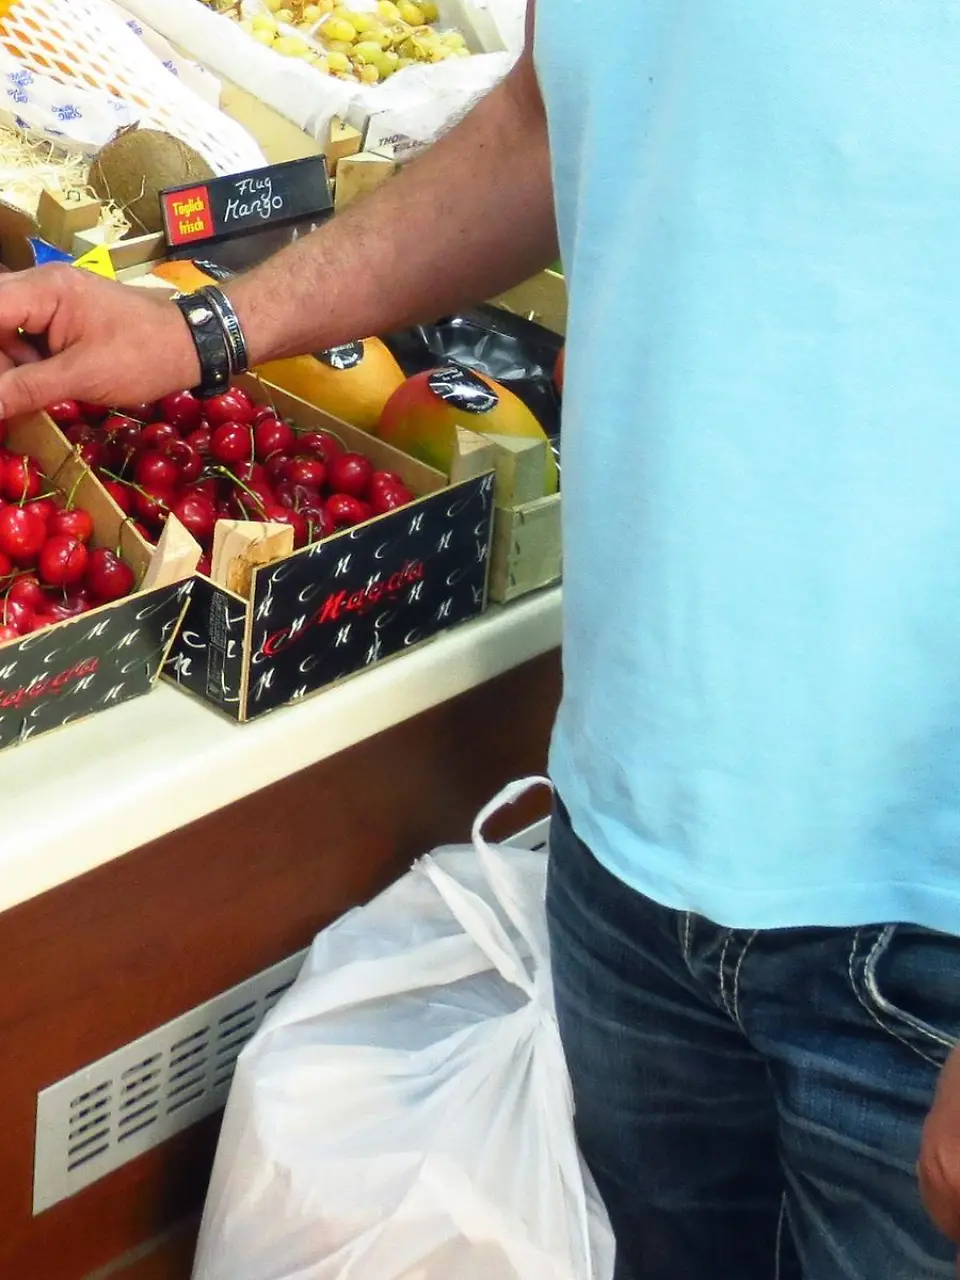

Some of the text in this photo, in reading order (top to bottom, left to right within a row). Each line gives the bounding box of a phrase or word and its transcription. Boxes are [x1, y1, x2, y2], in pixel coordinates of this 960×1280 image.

[235, 177, 273, 201] Flug
[172, 197, 205, 217] Täglich
[224, 195, 284, 223] Mango
[178, 217, 205, 236] frisch
